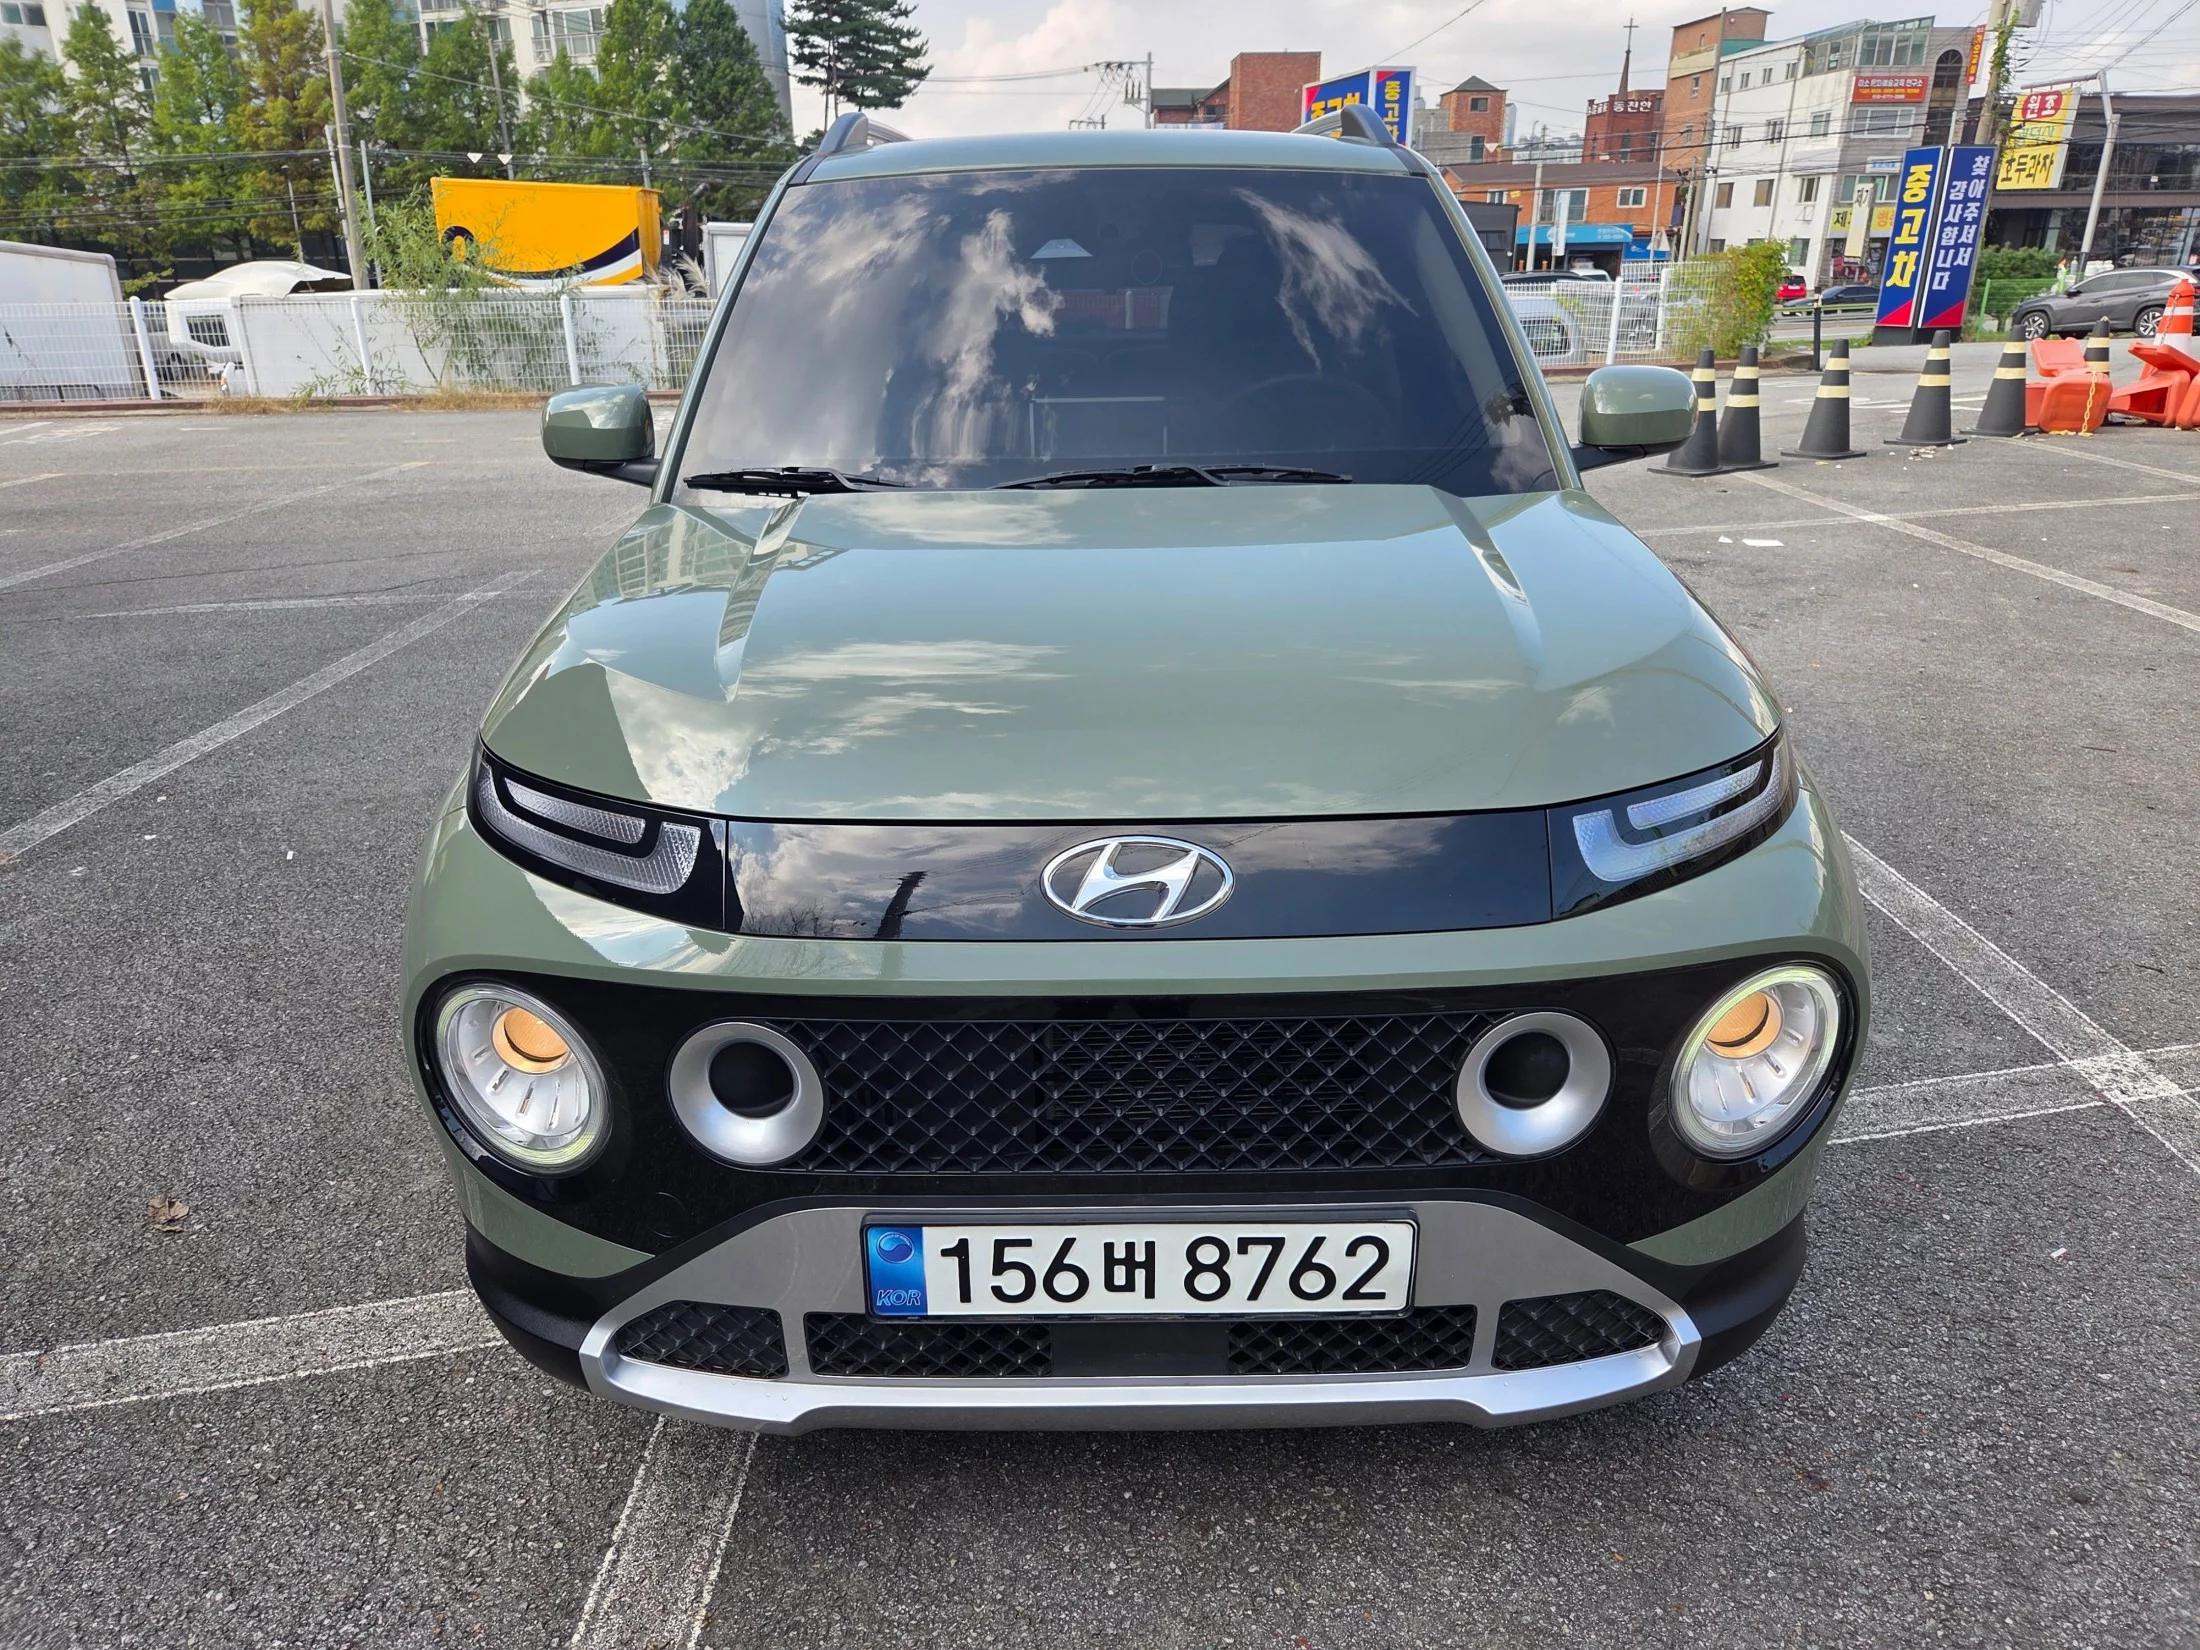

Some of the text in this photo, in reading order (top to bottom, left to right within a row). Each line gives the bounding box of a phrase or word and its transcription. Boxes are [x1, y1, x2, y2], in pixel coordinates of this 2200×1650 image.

[2026, 95, 2059, 118] 원조
[2001, 151, 2054, 184] 호두과자
[1886, 163, 1933, 288] 중고차
[1932, 180, 1968, 290] 감사합니다
[1953, 155, 1990, 267] 찾아주셔서
[876, 1290, 921, 1306] KOR
[1183, 1235, 1390, 1302] 8762
